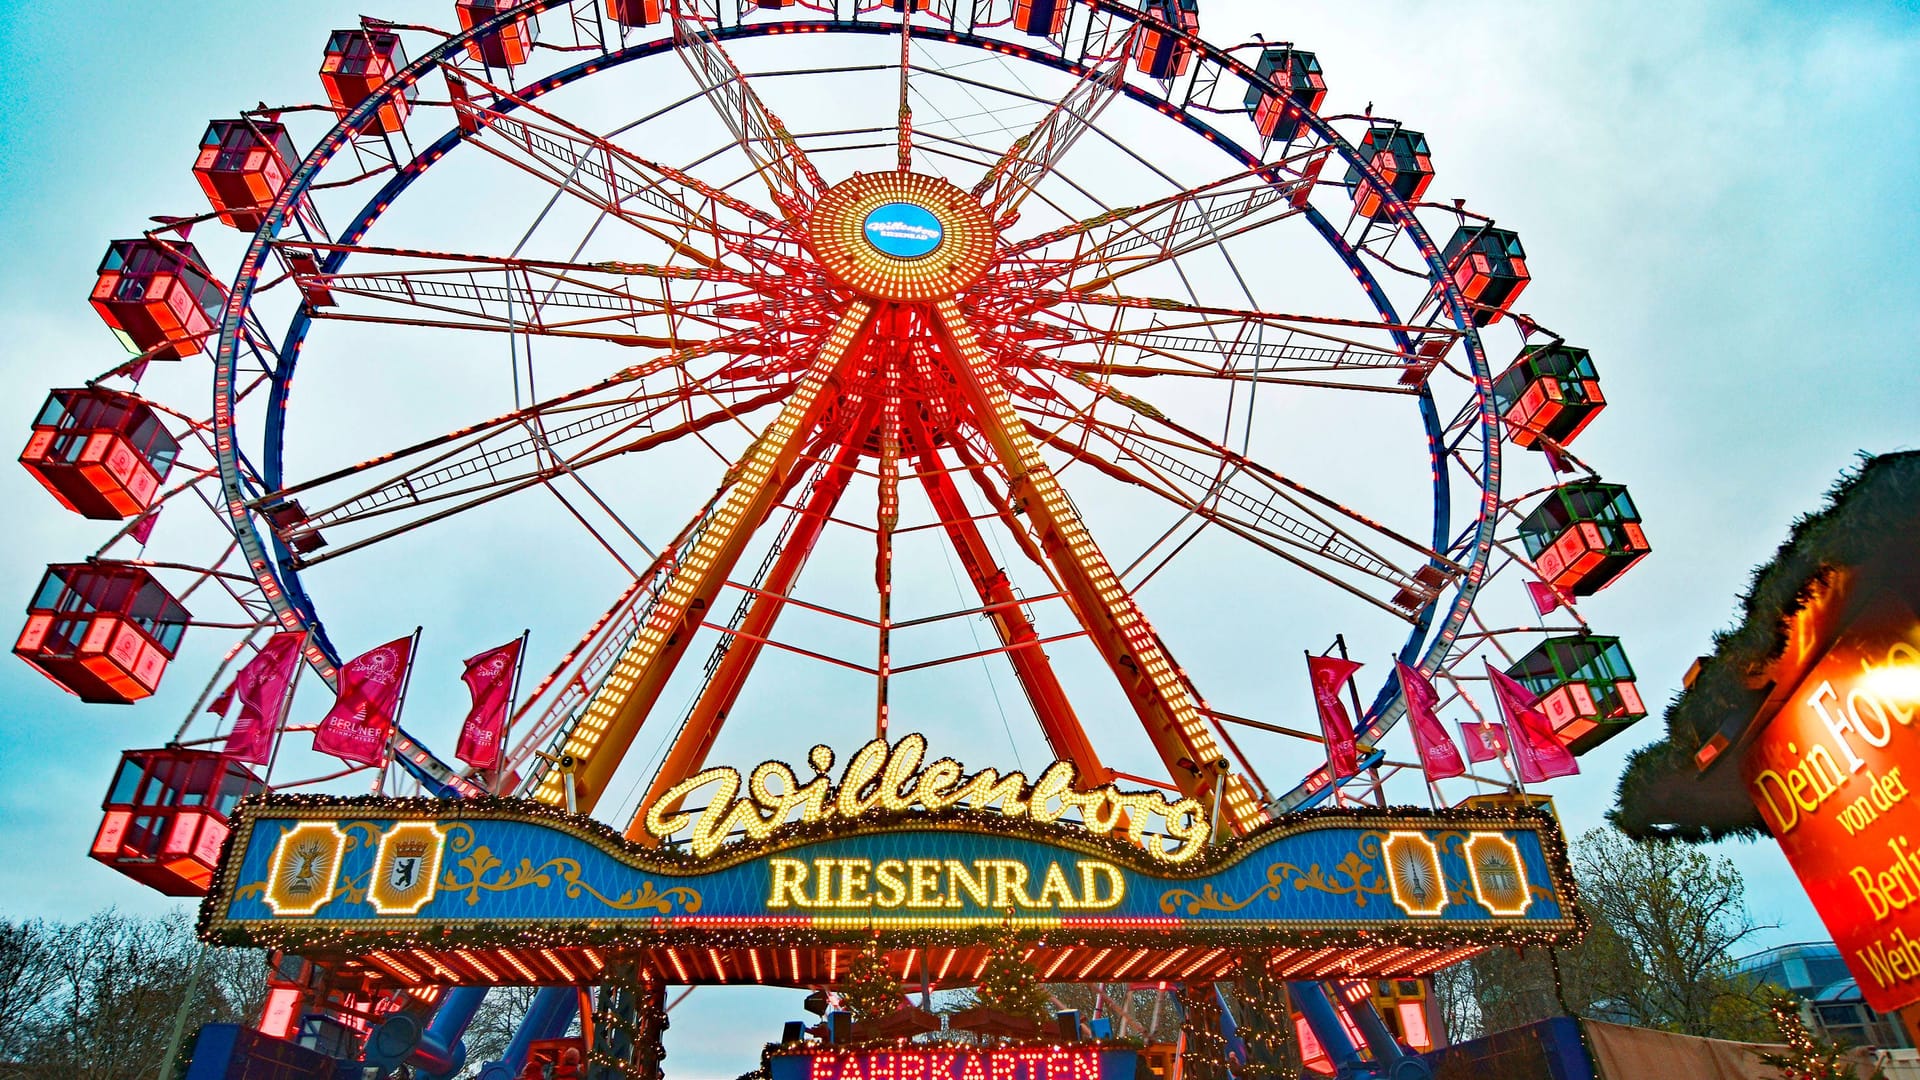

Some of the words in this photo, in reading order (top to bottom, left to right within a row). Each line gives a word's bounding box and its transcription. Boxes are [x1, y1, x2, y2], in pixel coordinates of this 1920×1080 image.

[645, 733, 1211, 863] Willenborg
[1754, 741, 1849, 834] Dein
[1836, 795, 1879, 836] von
[1865, 766, 1909, 811] der
[767, 859, 1124, 907] RIESENRAD
[813, 1052, 1099, 1080] FAHRKARTEN
